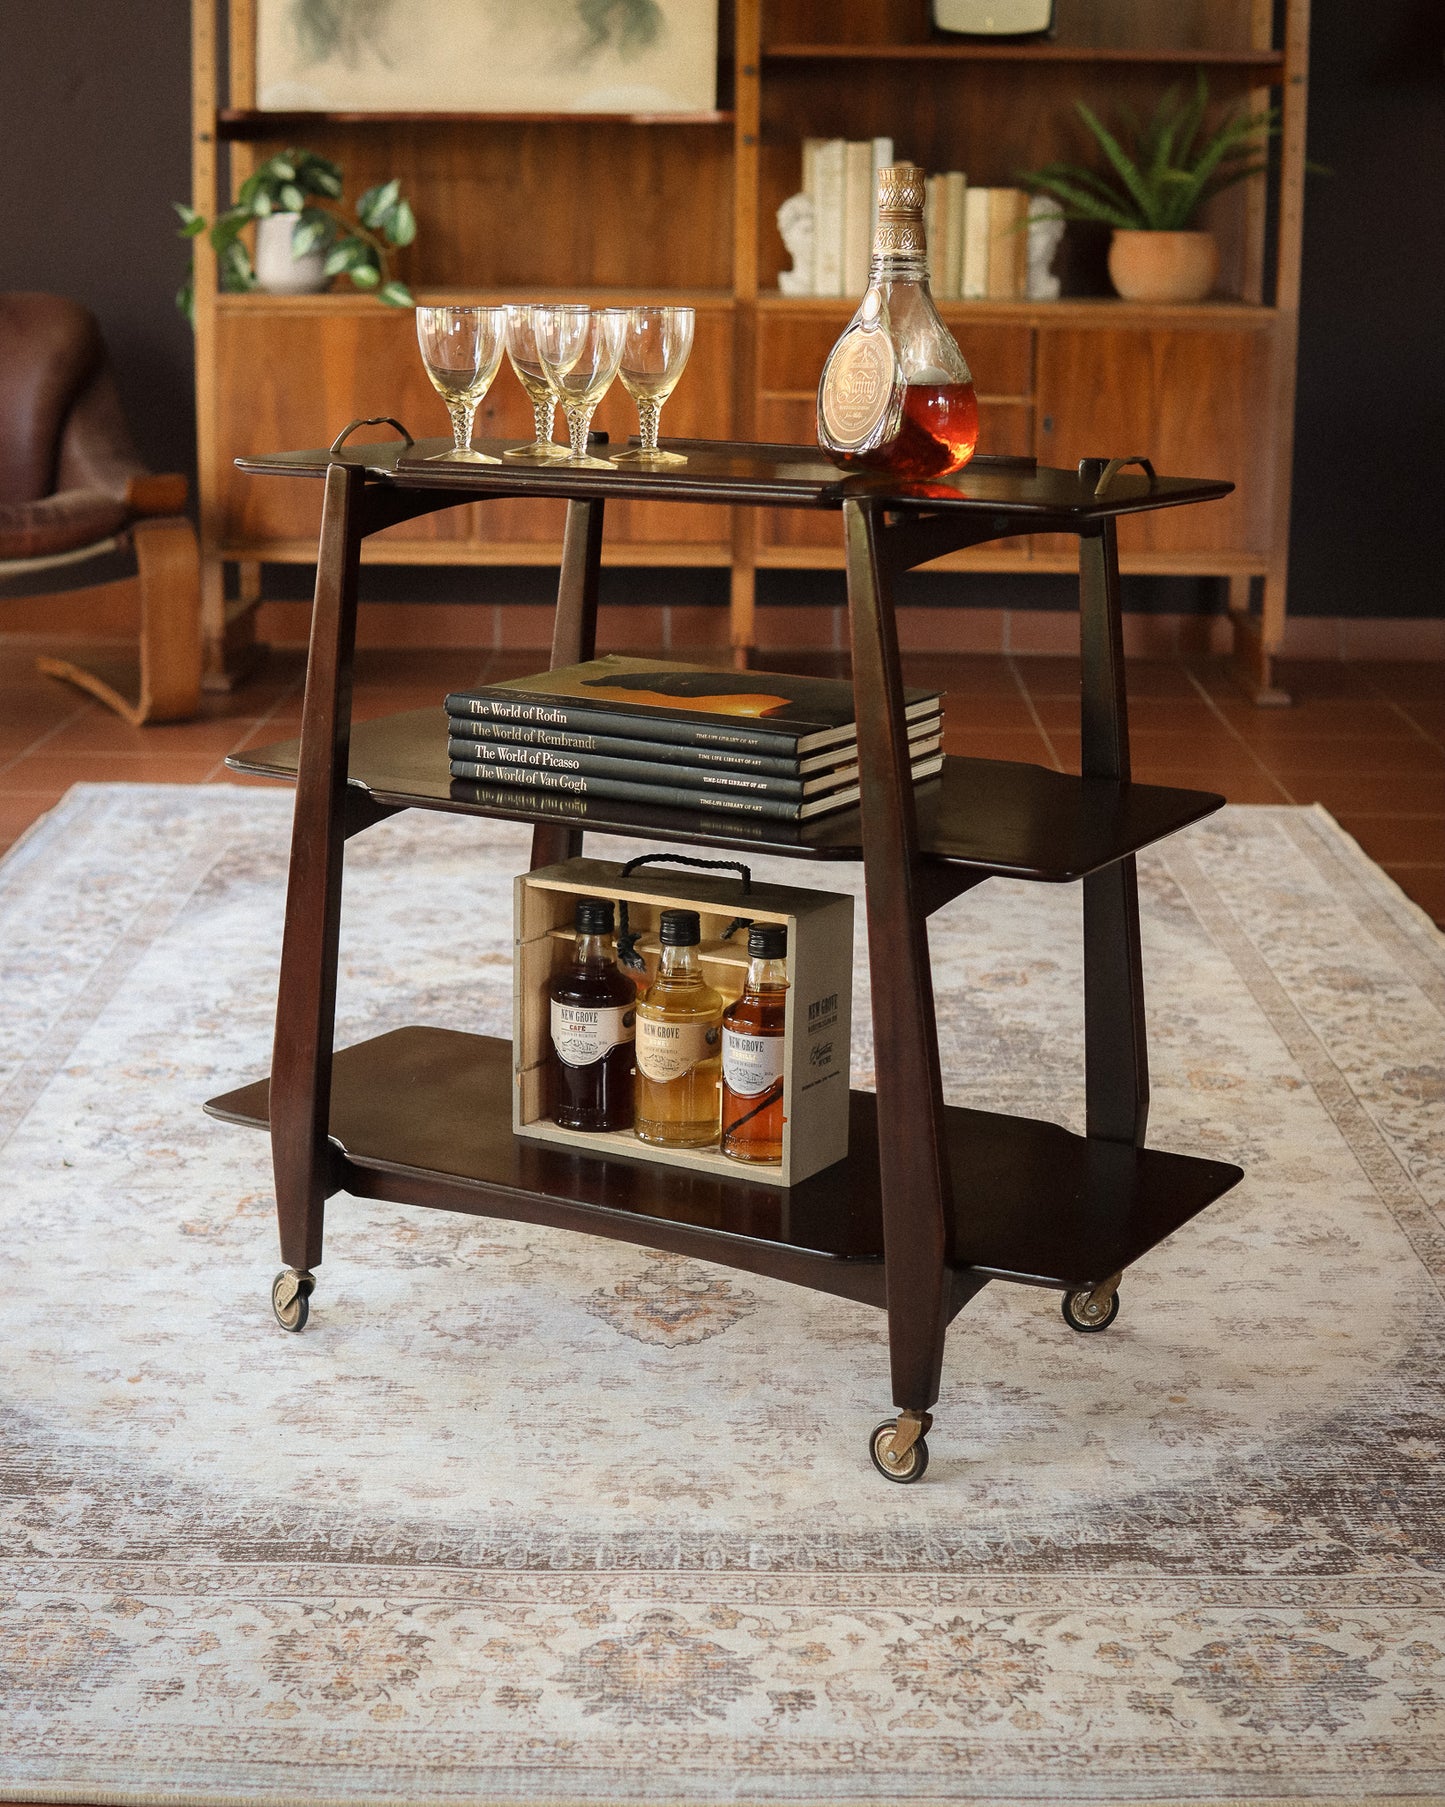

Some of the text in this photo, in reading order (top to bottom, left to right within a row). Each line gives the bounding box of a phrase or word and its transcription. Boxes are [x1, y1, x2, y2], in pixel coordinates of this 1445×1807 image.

[469, 700, 567, 723] The World of Rodin
[471, 722, 596, 750] The World of Rembrandt
[474, 744, 579, 769] The World of Picasso
[723, 756, 745, 764] LIBRARY
[474, 764, 587, 794] The World of Van Gogh
[703, 776, 728, 784] TIME-LIFE
[728, 779, 750, 787] LIBRARY
[700, 798, 722, 806] TIME-LIFE
[722, 801, 744, 809] LIBRARY
[561, 1008, 598, 1023] NEW GROVE
[808, 994, 838, 1020] NEW GROVE
[644, 1023, 680, 1039] NEW GROVE
[729, 1035, 764, 1052] NEW GROVE
